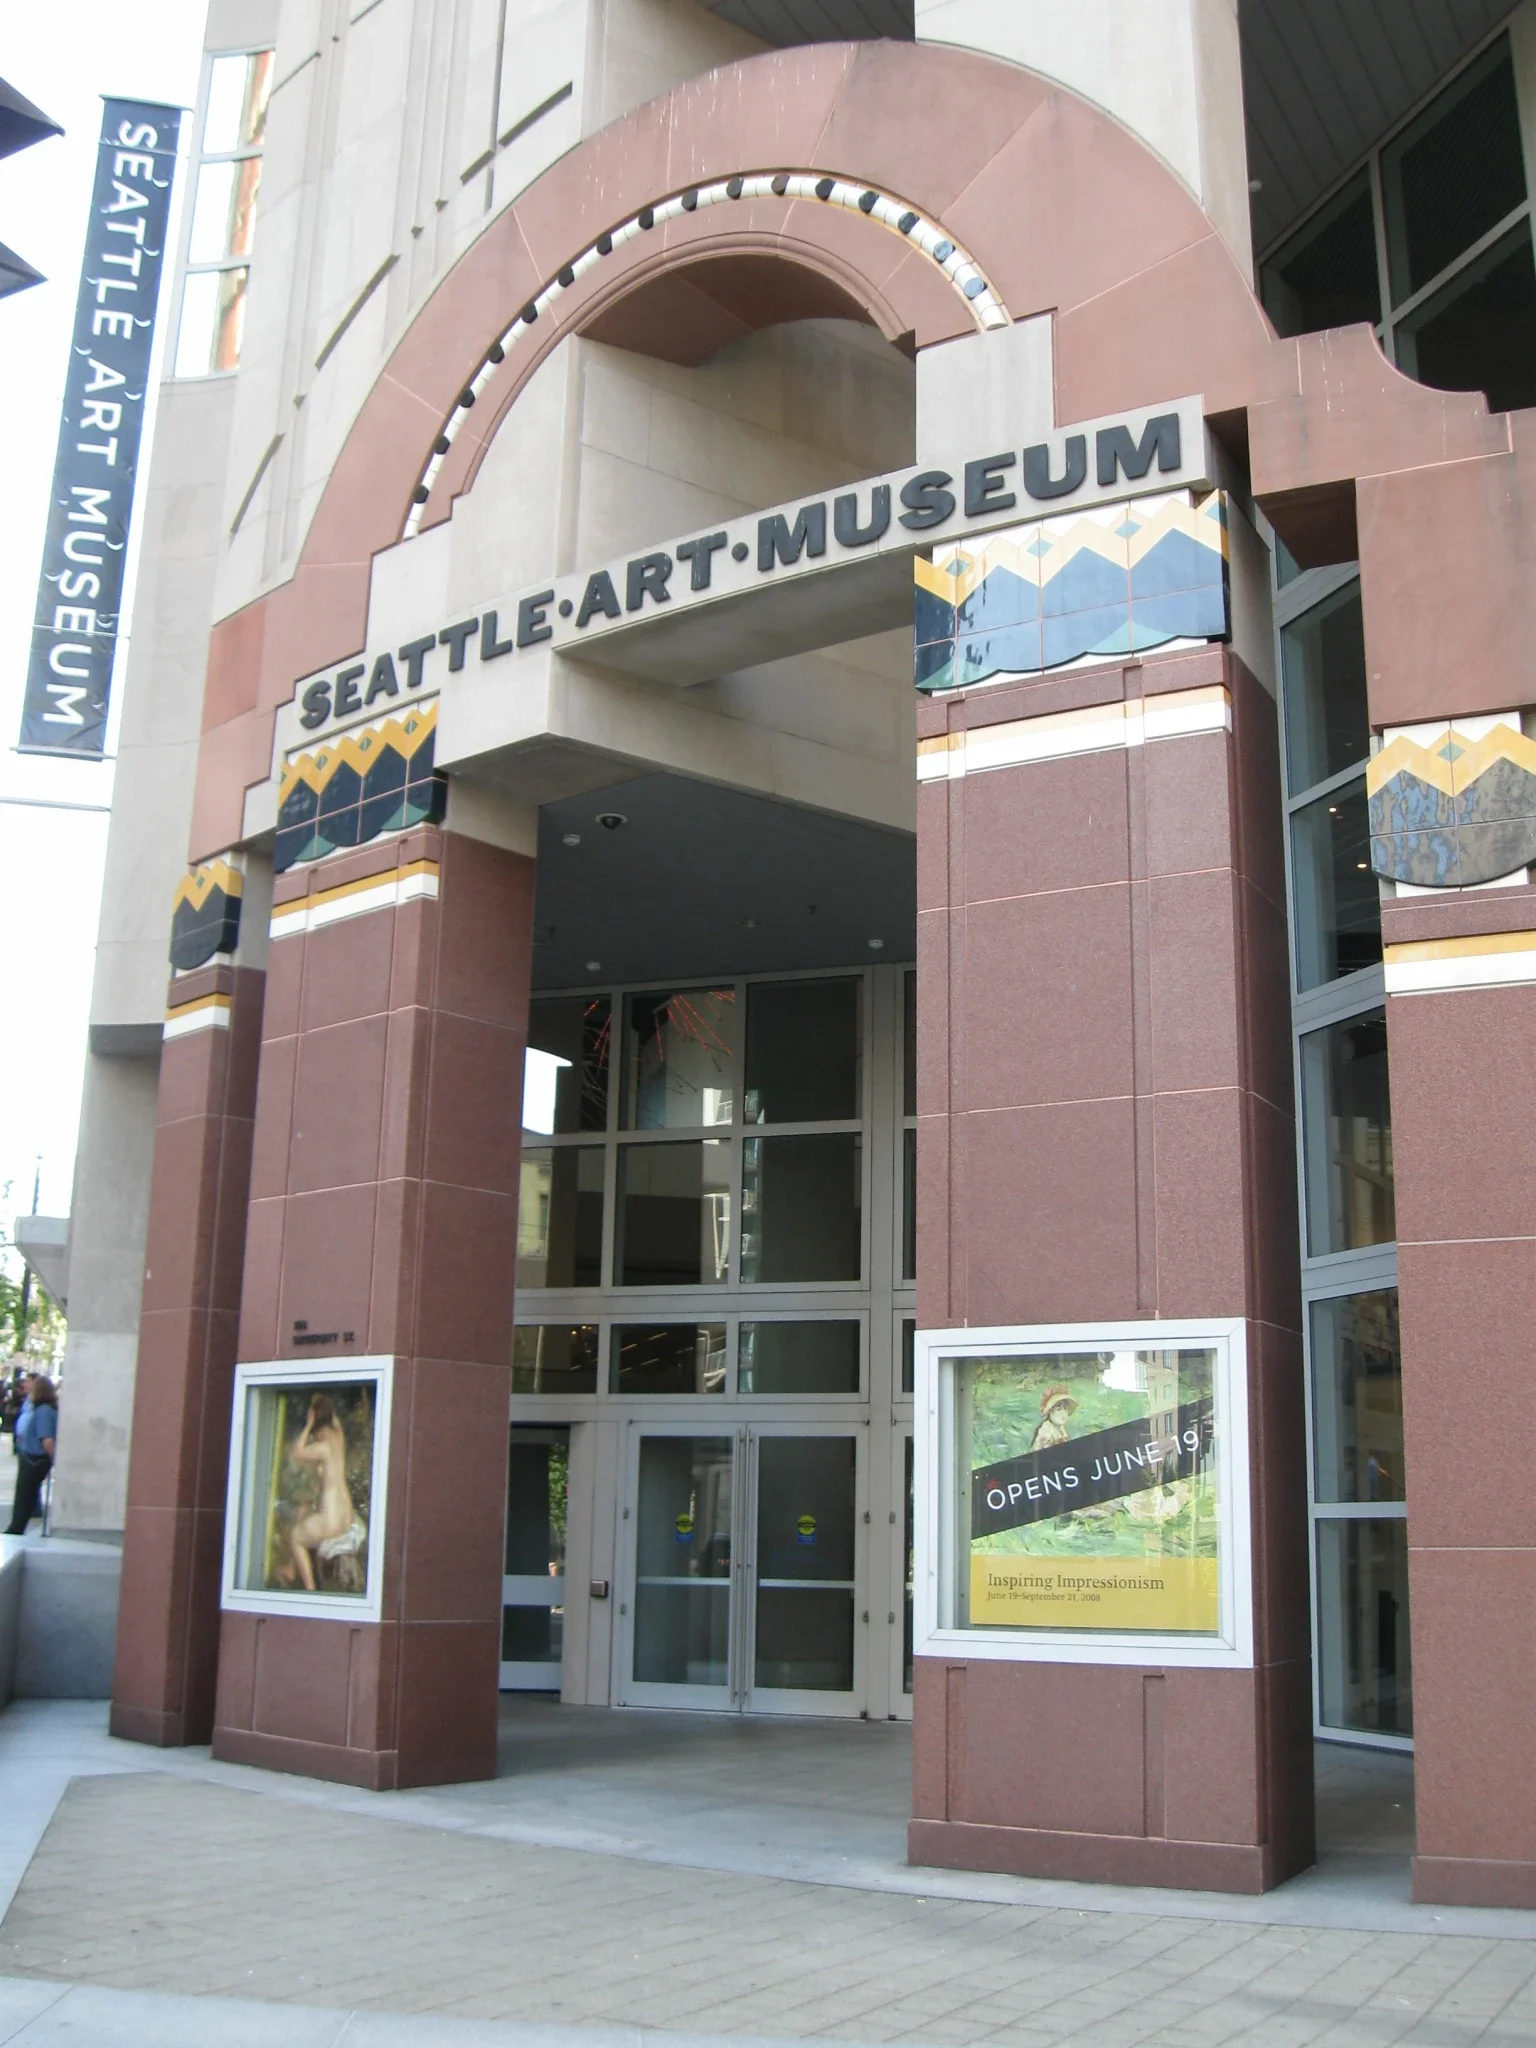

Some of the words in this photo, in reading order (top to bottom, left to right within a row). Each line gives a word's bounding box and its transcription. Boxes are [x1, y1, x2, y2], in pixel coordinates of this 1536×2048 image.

[91, 119, 158, 341] SEATTLE
[76, 357, 126, 467] ART
[42, 485, 112, 726] MUSEUM
[300, 588, 555, 730] SEATTLE
[757, 412, 1181, 572] MUSEUM
[986, 1466, 1080, 1510] OPENS
[1090, 1440, 1164, 1481] JUNE
[1170, 1429, 1200, 1456] 19
[987, 1573, 1053, 1590] Inspiring
[1057, 1574, 1165, 1592] Impressionism
[987, 1591, 1007, 1602] June
[1081, 1594, 1101, 1602] 2008
